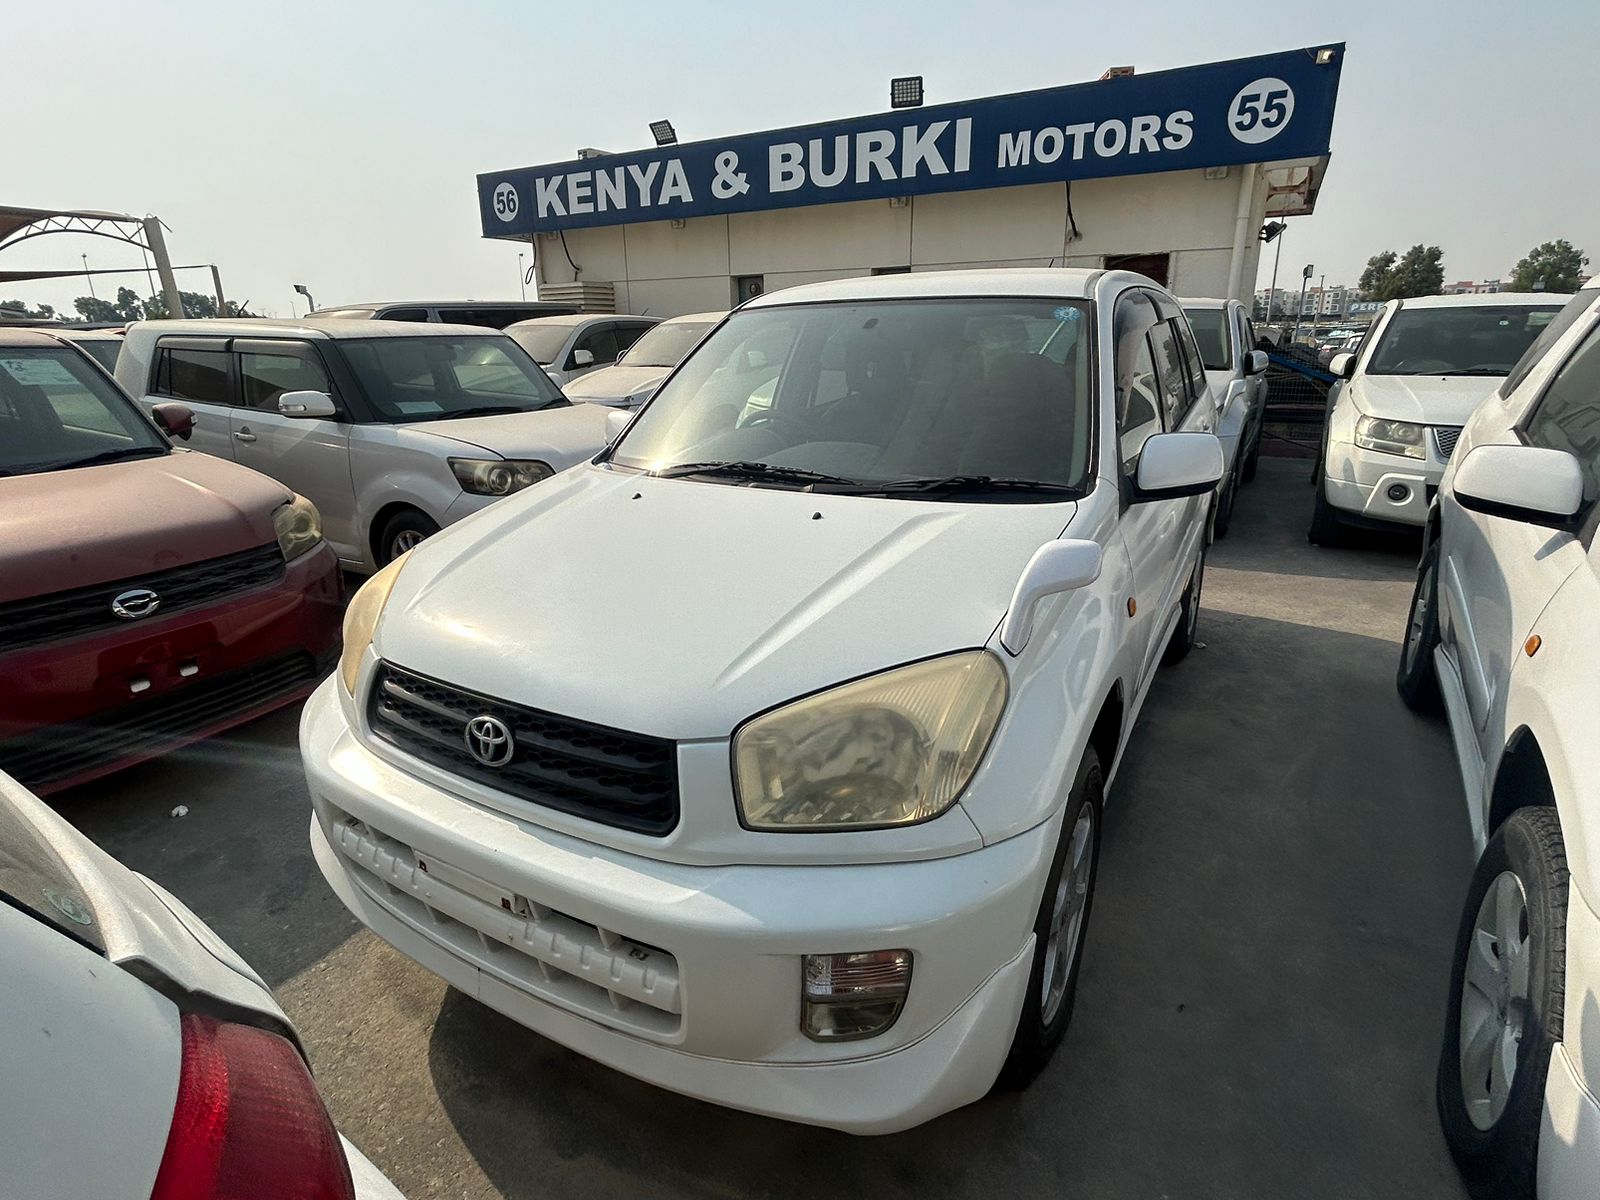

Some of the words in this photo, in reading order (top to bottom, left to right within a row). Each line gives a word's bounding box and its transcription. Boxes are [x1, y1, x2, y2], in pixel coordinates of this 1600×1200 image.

[1234, 88, 1289, 132] 55
[535, 158, 694, 219] KENYA
[711, 150, 751, 199] &
[768, 117, 973, 193] BURKI
[997, 110, 1194, 169] MOTORS
[496, 189, 517, 215] 56
